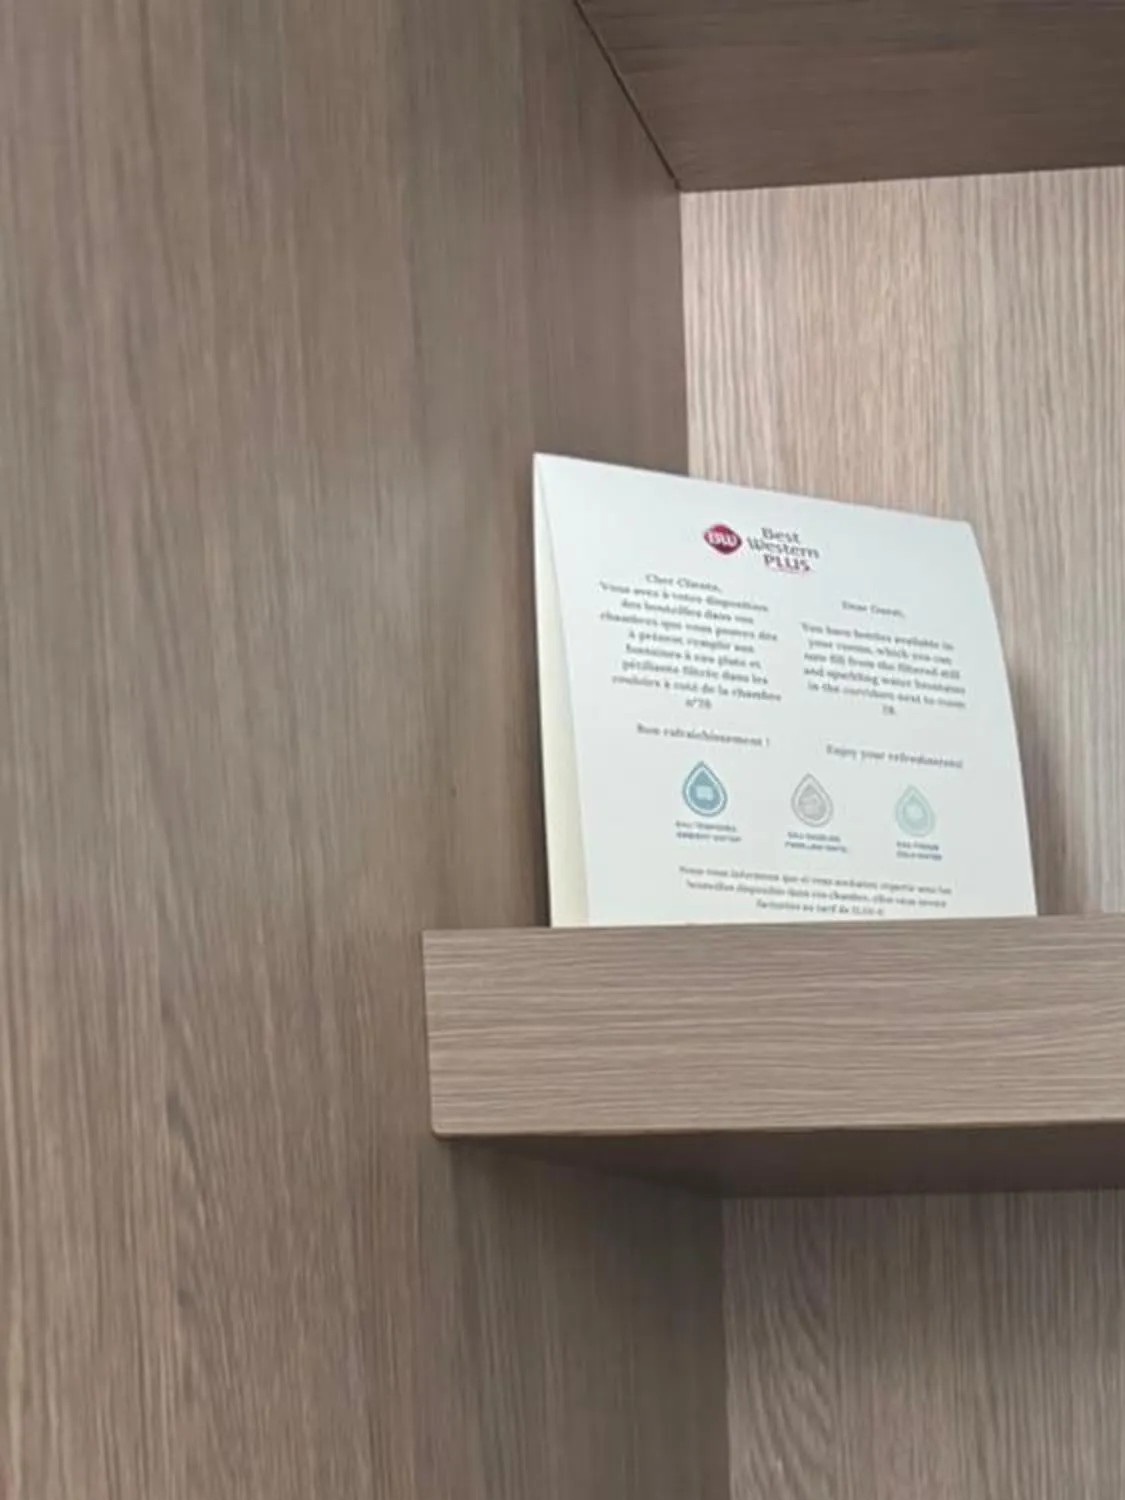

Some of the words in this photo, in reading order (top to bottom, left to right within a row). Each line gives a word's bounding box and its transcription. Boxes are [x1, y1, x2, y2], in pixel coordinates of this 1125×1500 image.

[761, 527, 799, 544] Best
[746, 536, 820, 559] Western
[763, 554, 810, 572] PLUS
[621, 598, 642, 610] des
[644, 601, 702, 618] bouteilles
[704, 609, 733, 622] dans
[706, 595, 769, 615] disposition
[685, 622, 713, 633] vous
[808, 639, 833, 652] your
[825, 625, 852, 638] have
[854, 629, 892, 644] bottles
[895, 634, 940, 650] available
[804, 664, 824, 677] and
[827, 667, 880, 687] sparkling
[847, 656, 875, 669] from
[897, 663, 939, 678] filtered
[821, 681, 840, 693] the
[637, 722, 660, 736] Bon
[826, 744, 858, 760] Enjoy
[860, 750, 886, 763] your
